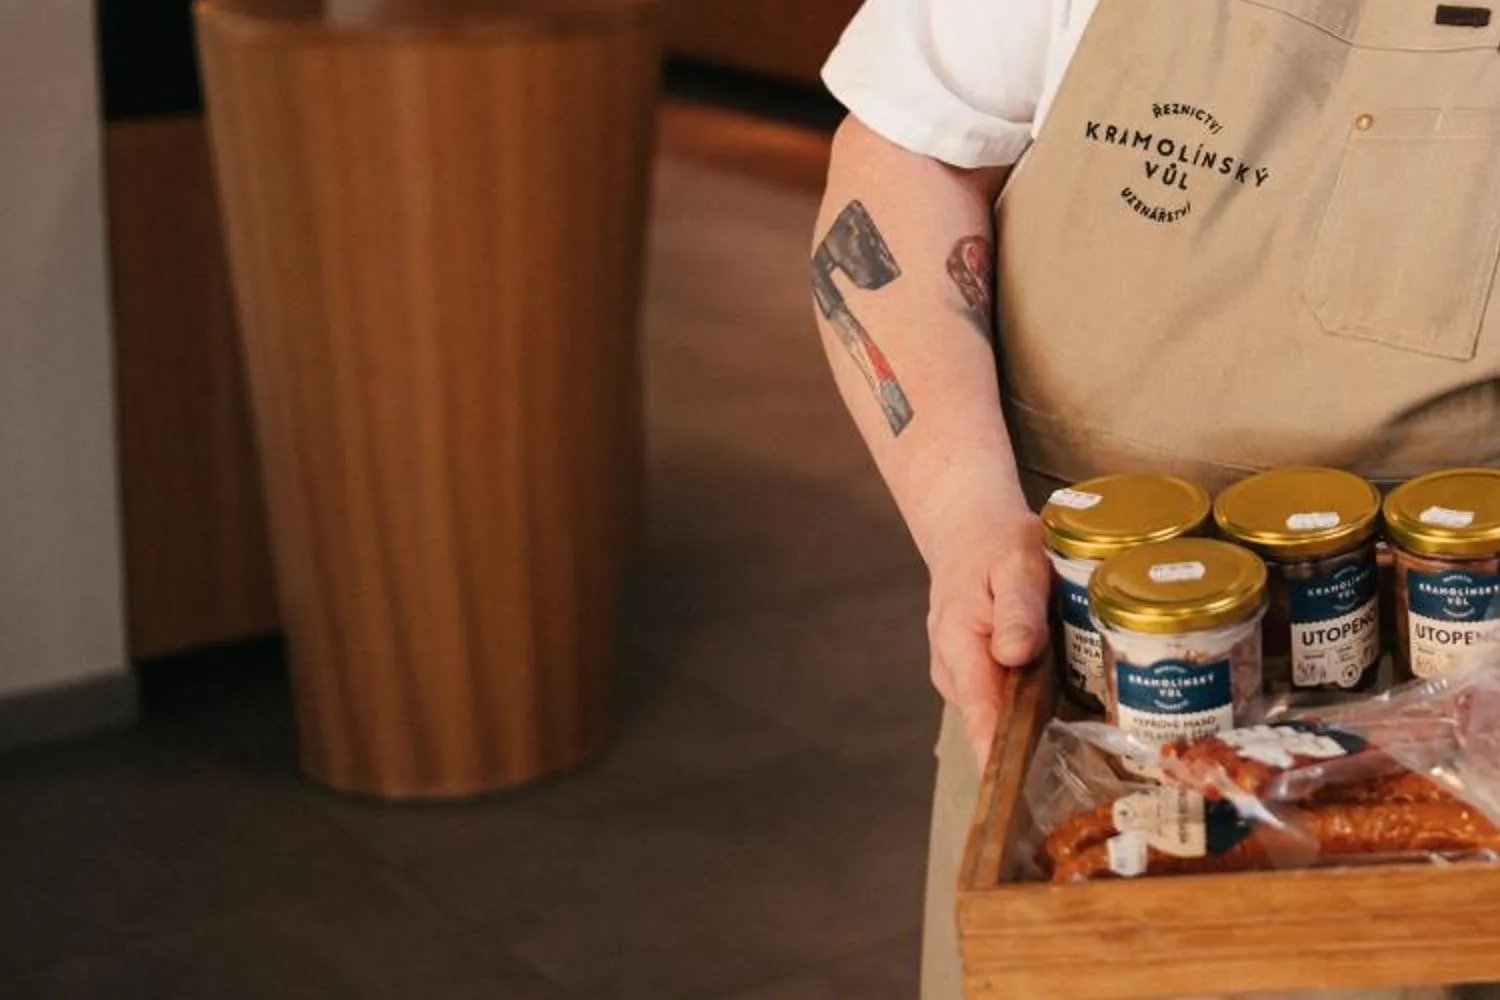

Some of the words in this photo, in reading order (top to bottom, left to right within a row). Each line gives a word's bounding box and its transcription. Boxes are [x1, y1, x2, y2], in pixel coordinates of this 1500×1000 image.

[1152, 103, 1225, 135] ŘEZNICTVÍ
[1085, 120, 1269, 187] KRAMOLÍNSKÝ
[1144, 162, 1189, 190] VŮL
[1120, 187, 1191, 223] UZENÁŘSTVÍ
